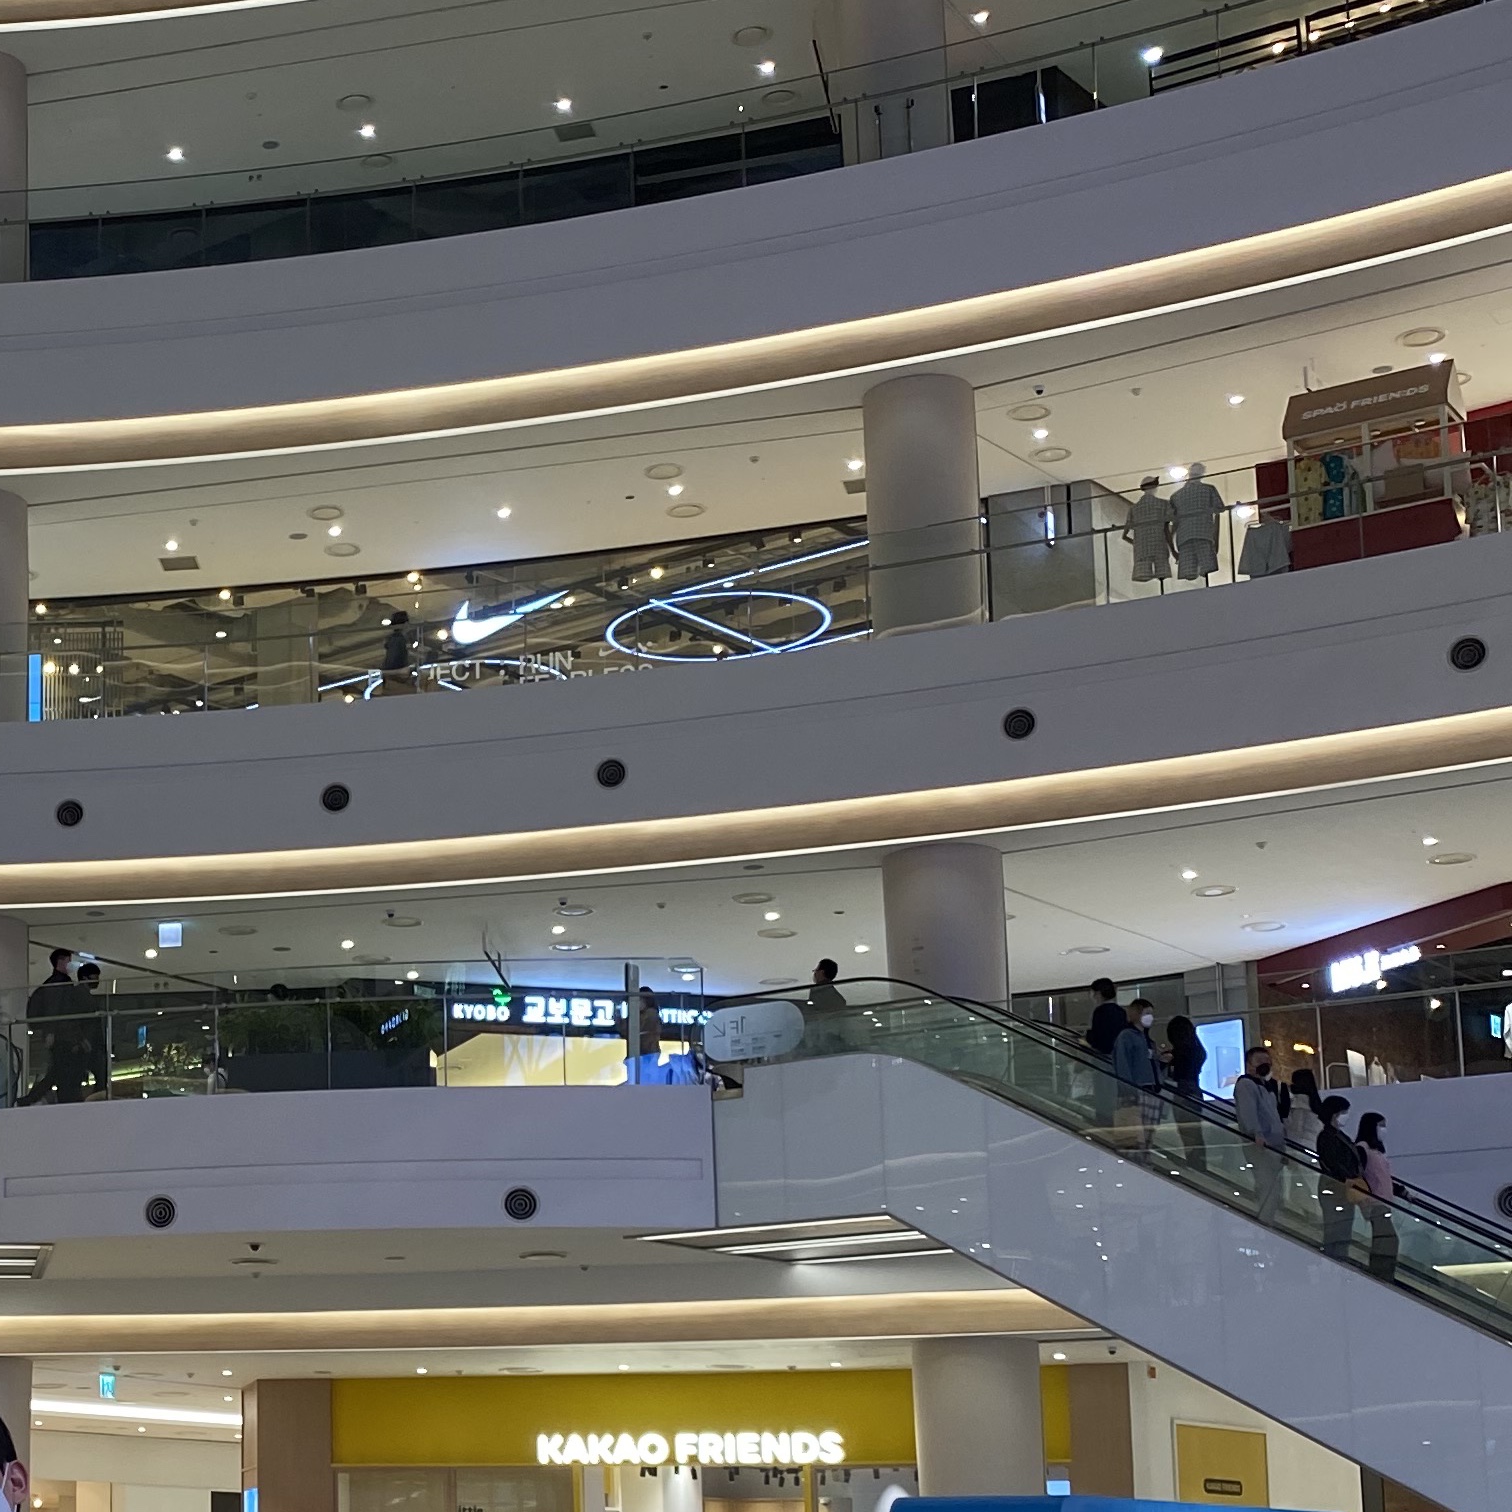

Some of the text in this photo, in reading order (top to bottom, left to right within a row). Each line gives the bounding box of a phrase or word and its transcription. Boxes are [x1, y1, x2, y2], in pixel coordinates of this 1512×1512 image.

[1350, 384, 1430, 409] FRIENDS
[453, 1002, 511, 1022] KYOBO
[522, 995, 616, 1026] 교보문고
[537, 1430, 845, 1465] KAKAO FRIENDS
